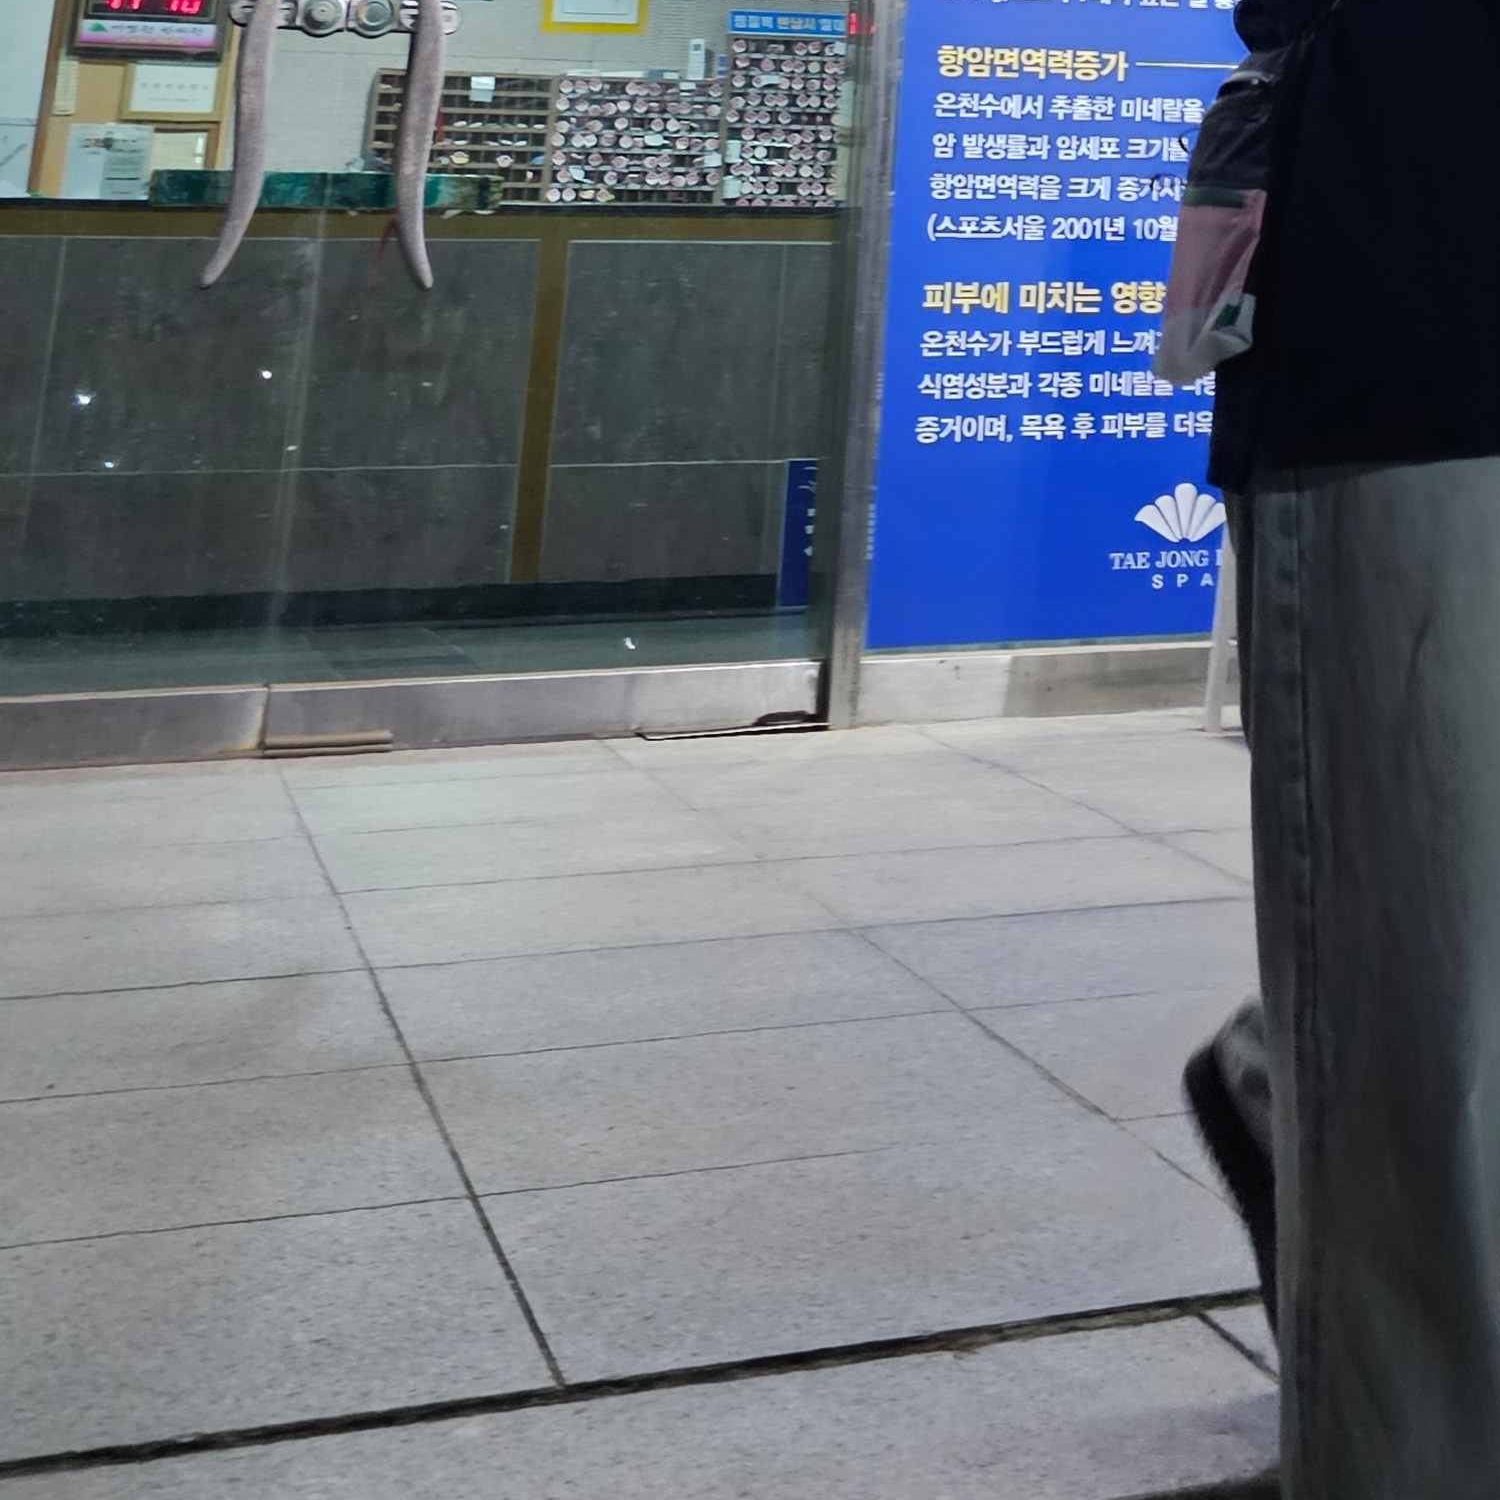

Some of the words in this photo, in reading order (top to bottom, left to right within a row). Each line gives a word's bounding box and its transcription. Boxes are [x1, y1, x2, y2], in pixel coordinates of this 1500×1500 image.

[937, 45, 1128, 81] 항암면역력증가
[933, 92, 1043, 119] 온천수에서
[1048, 95, 1115, 121] 추출한
[1121, 97, 1205, 123] 미네랄을
[932, 133, 957, 158] 암
[962, 134, 1051, 160] 발생률과
[1056, 136, 1120, 161] 암세포
[1125, 137, 1189, 163] 크기를
[929, 173, 1062, 200] 항암면역력을
[1066, 175, 1112, 201] 크게
[1116, 177, 1187, 202] 증가시
[927, 212, 1046, 241] (스포츠서울
[1051, 215, 1125, 241] 2001년
[1133, 216, 1178, 242] 10월
[923, 281, 1011, 314] 피부에
[1019, 281, 1102, 314] 미치는
[1110, 281, 1167, 314] 영향
[919, 329, 1012, 357] 온천수가
[1016, 329, 1106, 356] 부드럽게
[1111, 329, 1162, 355] 느껴
[917, 372, 1032, 399] 식염성분과
[1037, 372, 1083, 398] 각종
[915, 415, 1014, 443] 증거이며,
[1019, 414, 1067, 440] 목욕
[1071, 414, 1097, 439] 후
[1101, 412, 1168, 438] 피부를
[1174, 411, 1213, 437] 더욱
[1109, 552, 1151, 570] TAE
[1155, 549, 1209, 568] JONG
